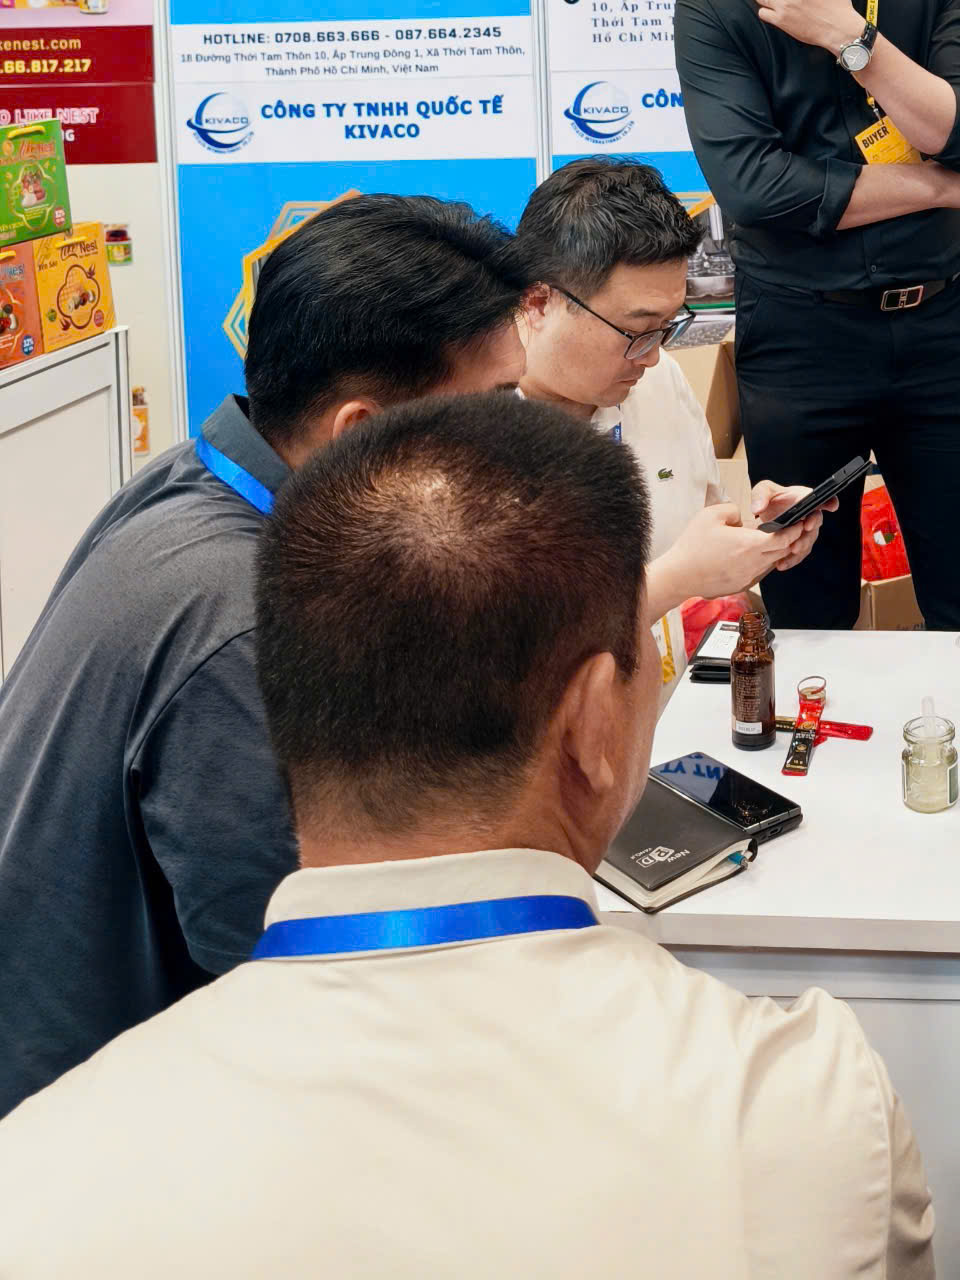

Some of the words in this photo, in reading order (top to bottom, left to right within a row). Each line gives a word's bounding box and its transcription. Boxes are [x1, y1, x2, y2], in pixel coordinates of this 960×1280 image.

[591, 2, 613, 13] 10,
[632, 17, 663, 27] Tam
[203, 33, 271, 45] HOTLINE:
[274, 31, 380, 43] 0708.663.666
[395, 27, 502, 41] 087.664.2345
[618, 31, 644, 42] Chí
[260, 52, 283, 62] Tam
[286, 51, 312, 62] Thôn
[314, 51, 330, 63] 10,
[350, 49, 380, 62] Trung
[414, 49, 423, 59] 1,
[470, 46, 493, 56] Tam
[495, 45, 526, 56] Thôn,
[361, 65, 390, 75] Minh,
[392, 63, 413, 74] Việt
[415, 64, 438, 73] Nam
[261, 100, 315, 119] CÔNG
[322, 103, 347, 118] TY
[354, 101, 409, 117] TNHH
[416, 95, 472, 118] QUỐC
[479, 94, 504, 114] TẾ
[641, 88, 684, 108] CÔN
[56, 107, 99, 124] NEST
[583, 106, 629, 114] KIVACO
[345, 123, 420, 140] KIVACO
[862, 125, 890, 149] BUYER
